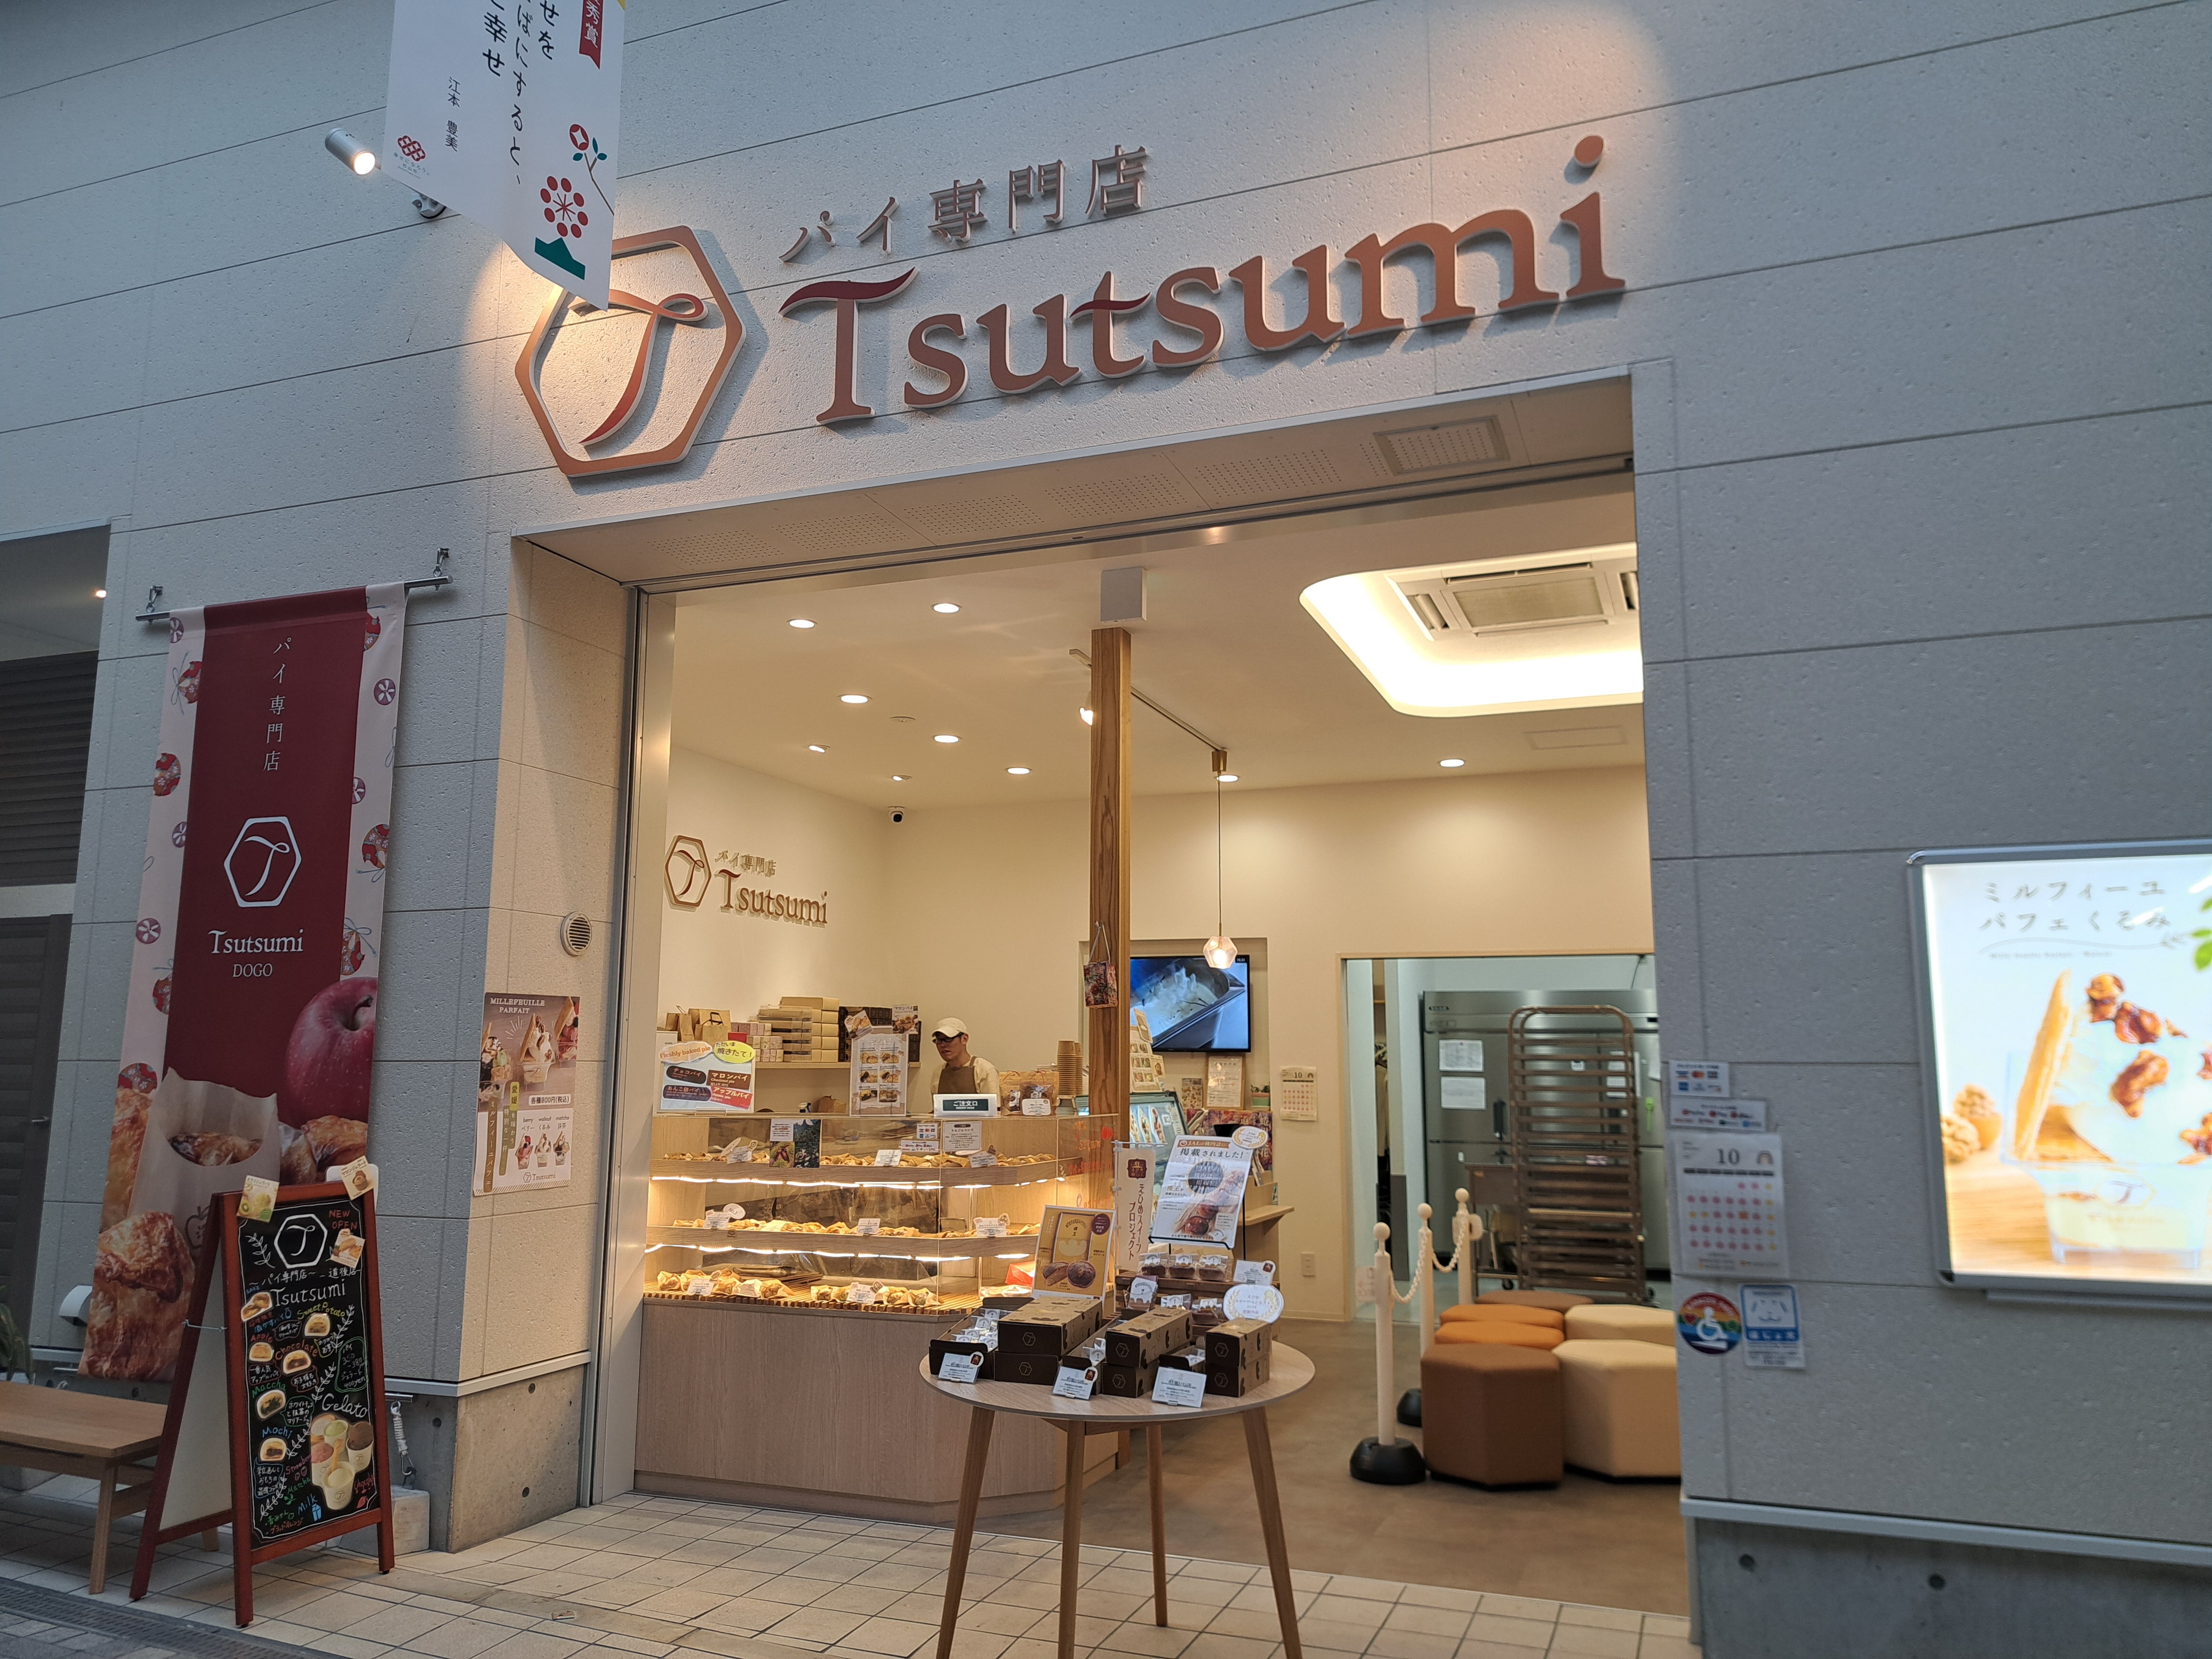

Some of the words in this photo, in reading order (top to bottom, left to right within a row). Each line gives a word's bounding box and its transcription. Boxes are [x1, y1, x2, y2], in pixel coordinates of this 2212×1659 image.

[584, 0, 600, 48] 秀賞
[448, 77, 460, 107] 江本
[778, 144, 1148, 263] パイ専門店
[778, 135, 1626, 425] Tsutsumi
[263, 637, 292, 772] パイ専門店
[716, 850, 776, 877] パイ専門店
[718, 869, 828, 924] Tsutsumi
[1985, 880, 2166, 903] ミルフィーユ
[208, 929, 304, 954] Tsutsumi
[232, 963, 273, 978] DOGO
[490, 998, 545, 1006] MILLEFEUILLE
[682, 1048, 700, 1056] baked
[674, 1068, 701, 1077] チョコパイ
[711, 1073, 748, 1081] マロンパイ
[713, 1087, 749, 1099] アップルパイ
[486, 1101, 496, 1185] ミルフィーユパフェ
[1180, 1148, 1243, 1159] 掲載されました!
[1717, 1148, 1740, 1164] 10
[533, 1172, 556, 1181] Tsutsumi
[329, 1210, 350, 1218] NEW
[332, 1221, 358, 1230] OPEN
[246, 1285, 261, 1294] SAKE
[270, 1279, 346, 1307] Tsutsumi
[251, 1333, 273, 1343] Apple
[275, 1339, 318, 1360] Chocolate
[251, 1370, 279, 1383] アップルパイ
[252, 1379, 287, 1398] Maccha
[321, 1393, 368, 1418] Gelato
[262, 1426, 293, 1439] Mochi
[298, 1493, 318, 1515] Milk
